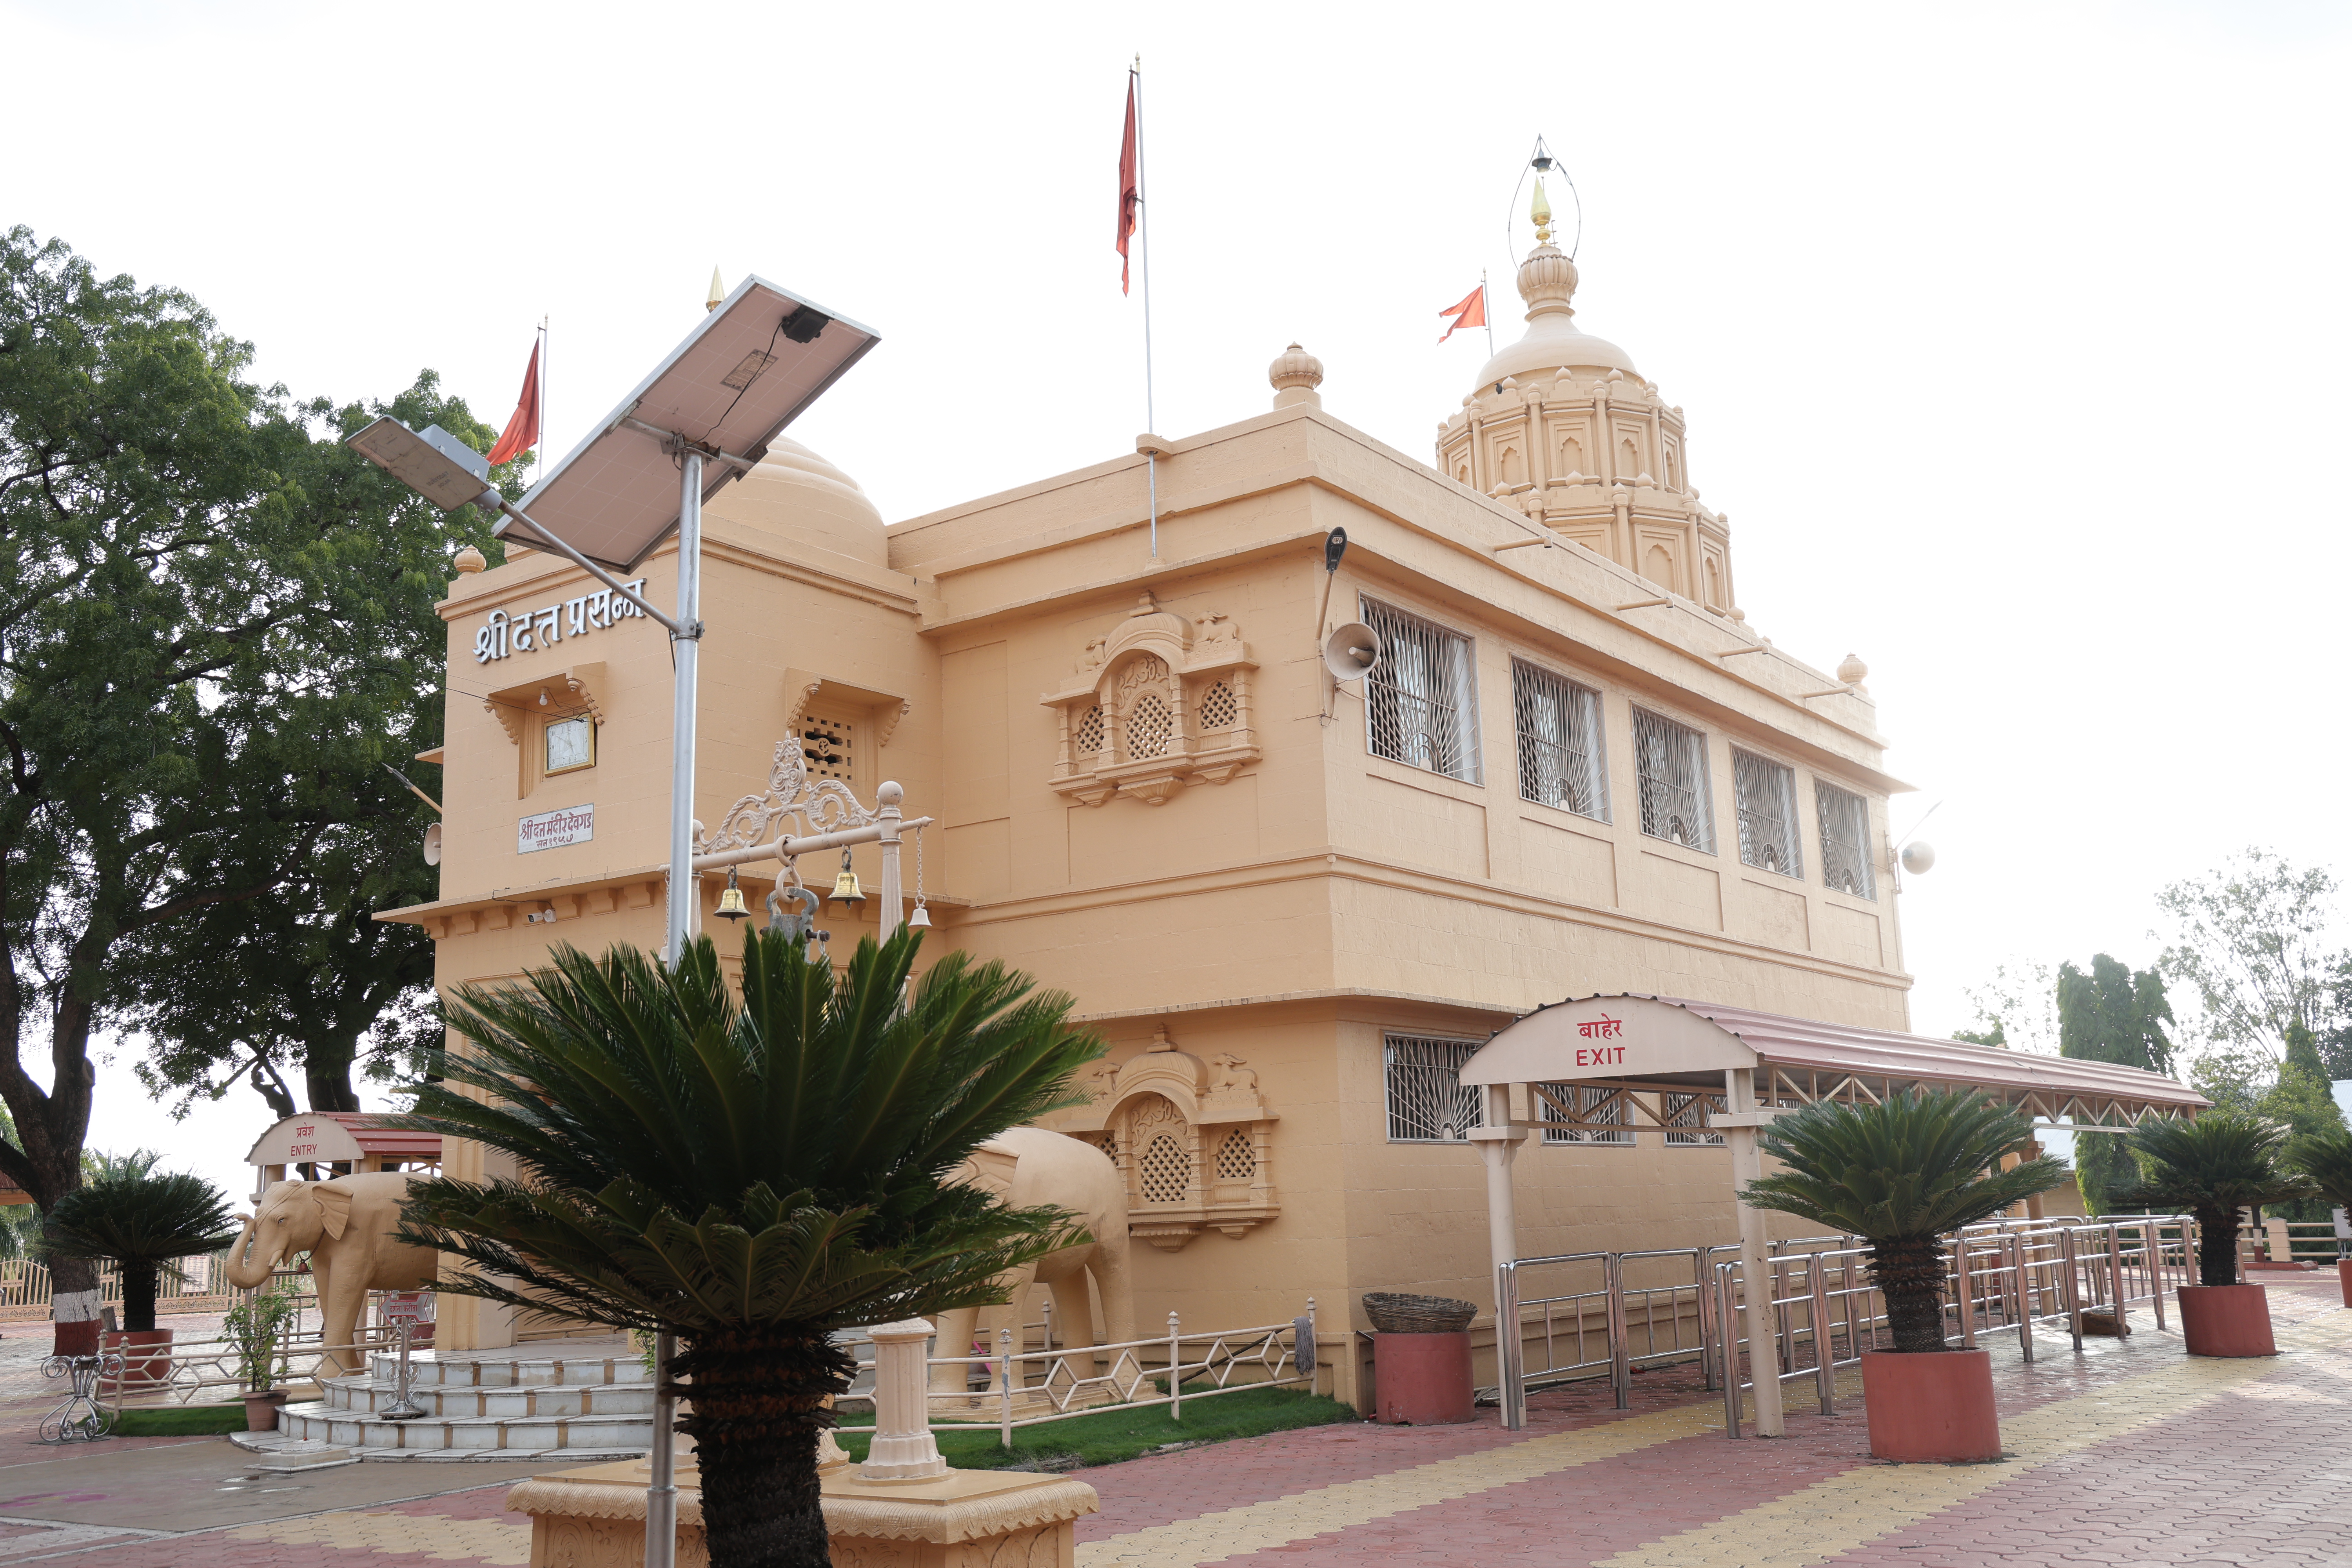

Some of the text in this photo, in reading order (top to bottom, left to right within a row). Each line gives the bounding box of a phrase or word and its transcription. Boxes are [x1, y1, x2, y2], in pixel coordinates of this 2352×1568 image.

[473, 578, 647, 664] श्री दत्त प्रसन्न
[520, 811, 592, 840] श्री दत्त मंदीर देवगड
[536, 834, 573, 849] सन १९५७
[1576, 1013, 1622, 1040] बाहेर
[1576, 1047, 1625, 1066] EXIT
[296, 1122, 315, 1138] प्रवेश
[291, 1144, 317, 1156] ENTRY
[390, 1302, 417, 1313] दर्शना करीता
